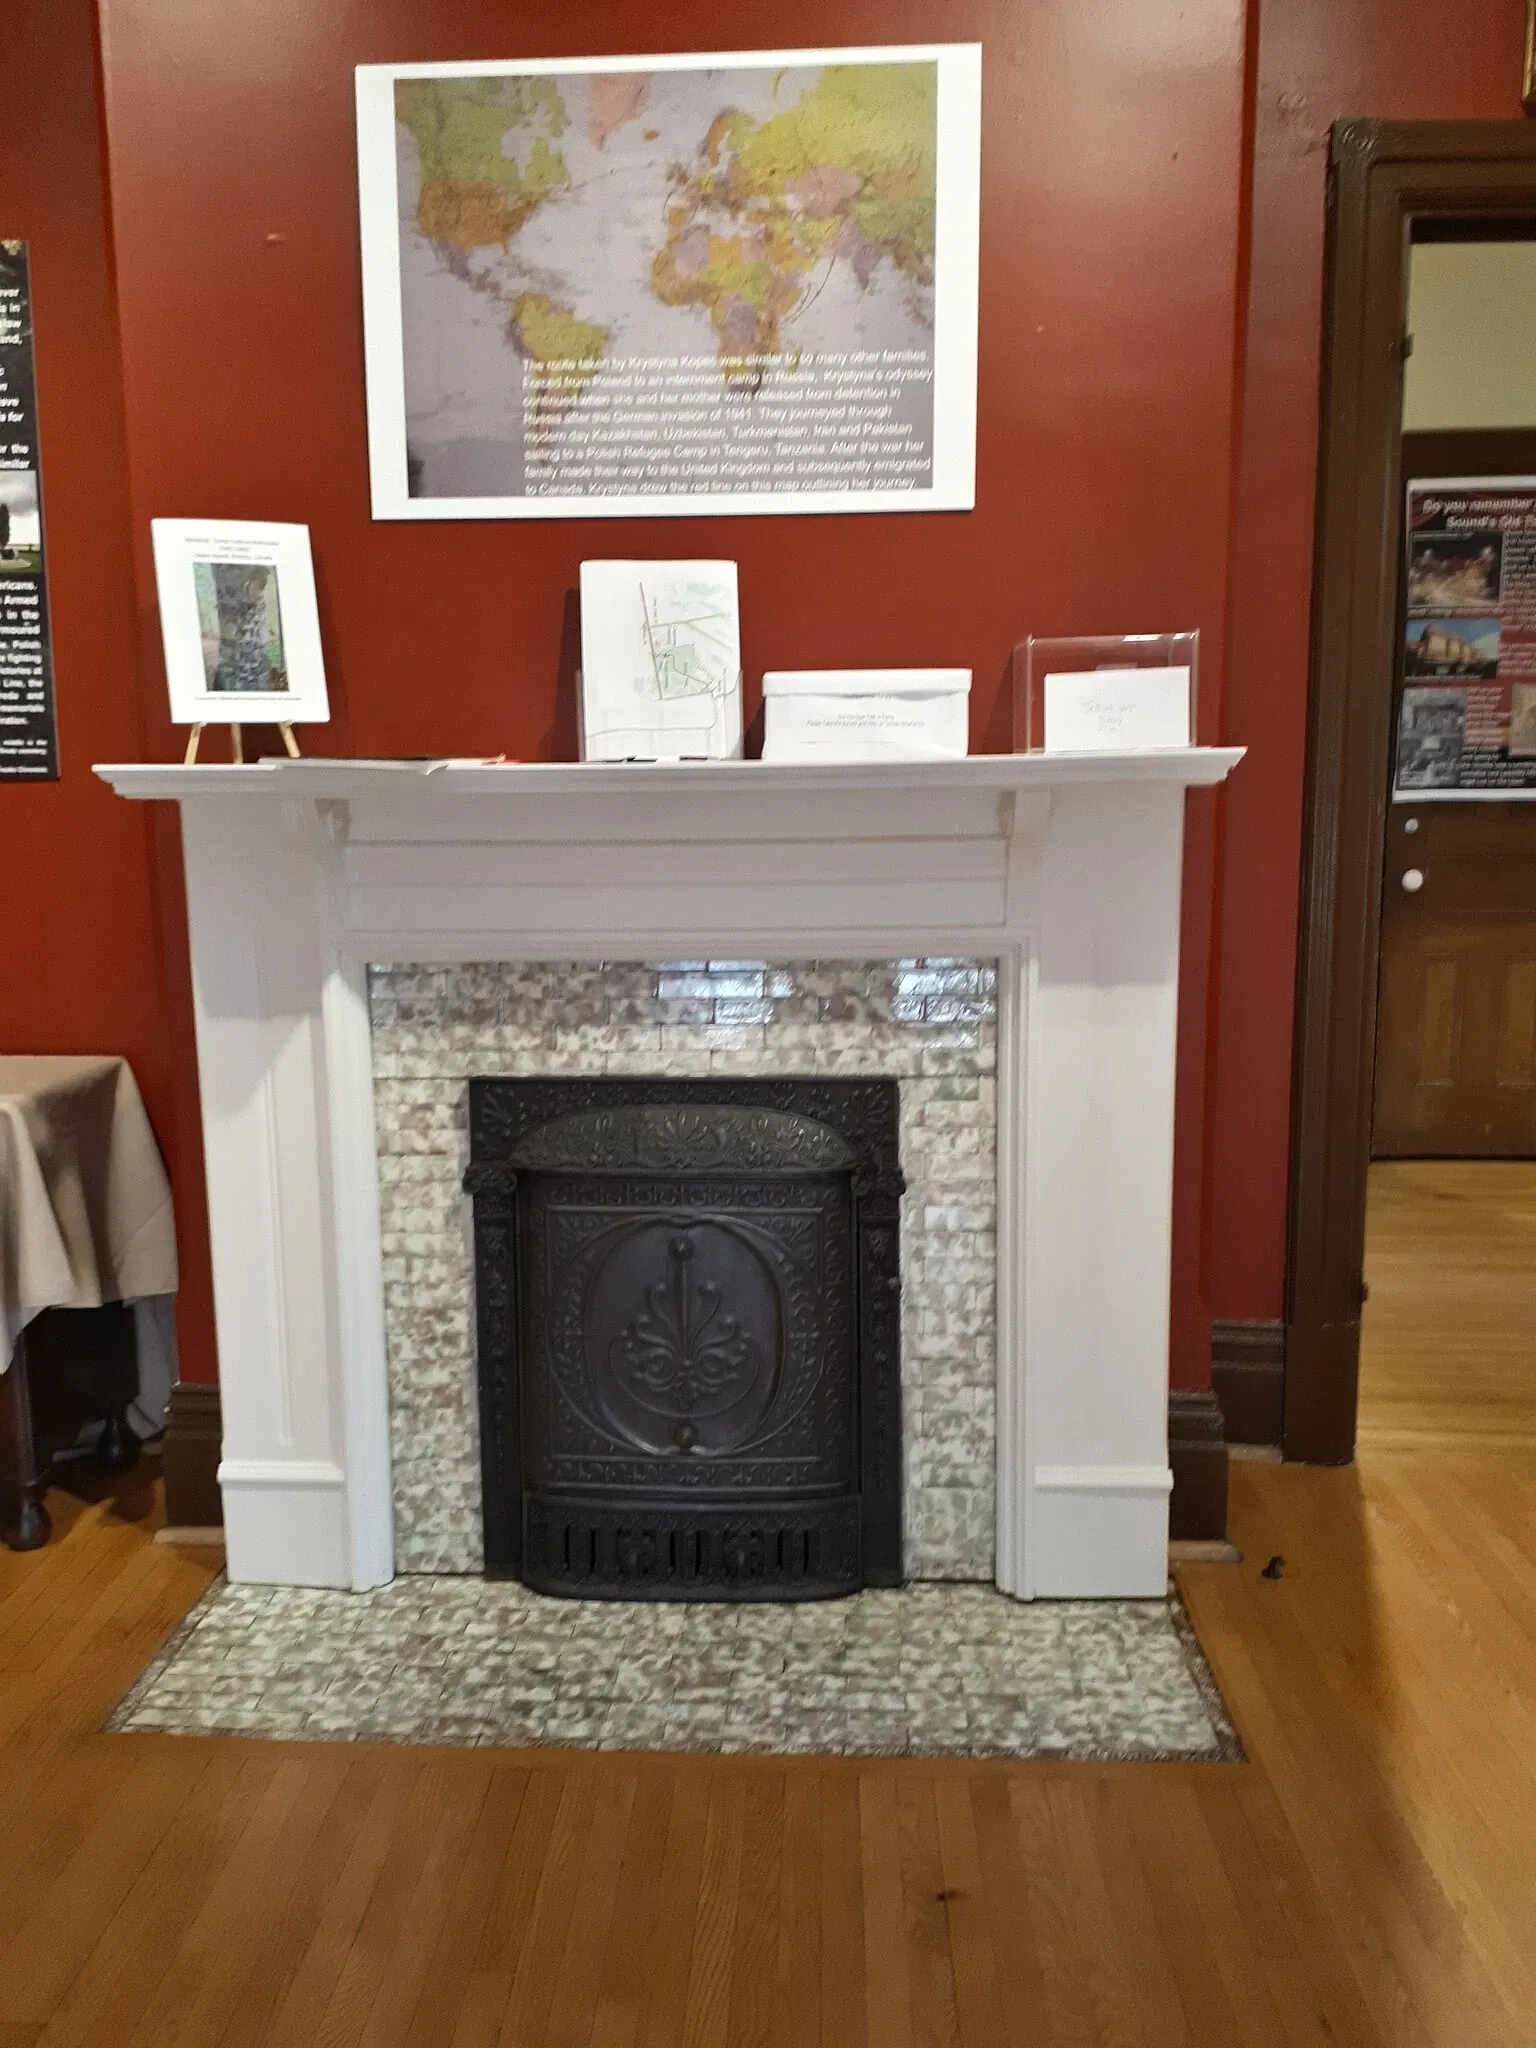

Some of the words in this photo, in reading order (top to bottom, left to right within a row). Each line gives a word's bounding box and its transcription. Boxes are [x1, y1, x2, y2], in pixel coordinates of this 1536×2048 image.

[523, 358, 545, 371] The
[611, 357, 626, 373] by
[628, 356, 679, 372] Krystyna
[720, 355, 744, 367] was
[745, 353, 782, 366] similar
[785, 353, 797, 365] to
[800, 353, 813, 364] so
[816, 351, 848, 367] many
[850, 350, 880, 364] other
[564, 375, 590, 388] from
[592, 374, 632, 387] Poland
[634, 375, 645, 387] to
[648, 376, 663, 387] an
[728, 371, 760, 387] camp
[762, 371, 772, 384] in
[824, 367, 883, 385] Krystyna's
[885, 366, 933, 384] odyssey
[580, 392, 609, 406] when
[613, 391, 633, 405] she
[636, 391, 657, 405] and
[661, 390, 677, 404] her
[681, 390, 720, 404] mother
[724, 390, 751, 403] were
[754, 387, 803, 402] released
[806, 386, 832, 401] from
[834, 386, 887, 401] detention
[890, 385, 901, 400] in
[564, 410, 589, 424] after
[591, 410, 611, 423] the
[614, 409, 658, 423] German
[661, 408, 708, 422] invasion
[710, 407, 722, 421] of
[759, 405, 787, 422] They
[789, 404, 845, 422] journeyed
[847, 404, 892, 420] through
[524, 430, 566, 443] modern
[568, 429, 589, 443] day
[813, 423, 836, 437] Iran
[838, 423, 860, 437] and
[863, 421, 912, 437] Pakistan
[562, 447, 574, 460] to
[576, 449, 585, 460] a
[586, 446, 621, 460] Polish
[623, 446, 670, 461] Refugee
[673, 445, 707, 459] Camp
[709, 444, 720, 458] in
[830, 440, 858, 455] After
[861, 440, 879, 454] the
[882, 440, 902, 453] war
[905, 438, 924, 453] her
[524, 464, 557, 480] family
[560, 464, 592, 478] made
[594, 463, 619, 478] their
[622, 464, 645, 480] way
[646, 463, 658, 477] to
[660, 462, 679, 476] the
[681, 460, 718, 475] United
[720, 460, 770, 477] Kingdom
[773, 460, 795, 474] and
[797, 458, 871, 476] subsequently
[873, 457, 931, 473] emigrated
[525, 482, 537, 496] to
[588, 481, 638, 496] Krystyna
[639, 481, 668, 495] drew
[670, 480, 687, 494] the
[691, 480, 709, 493] red
[711, 480, 731, 493] line
[734, 481, 749, 493] on
[751, 479, 771, 492] this
[774, 479, 800, 493] map
[802, 477, 849, 492] outlining
[852, 477, 871, 491] her
